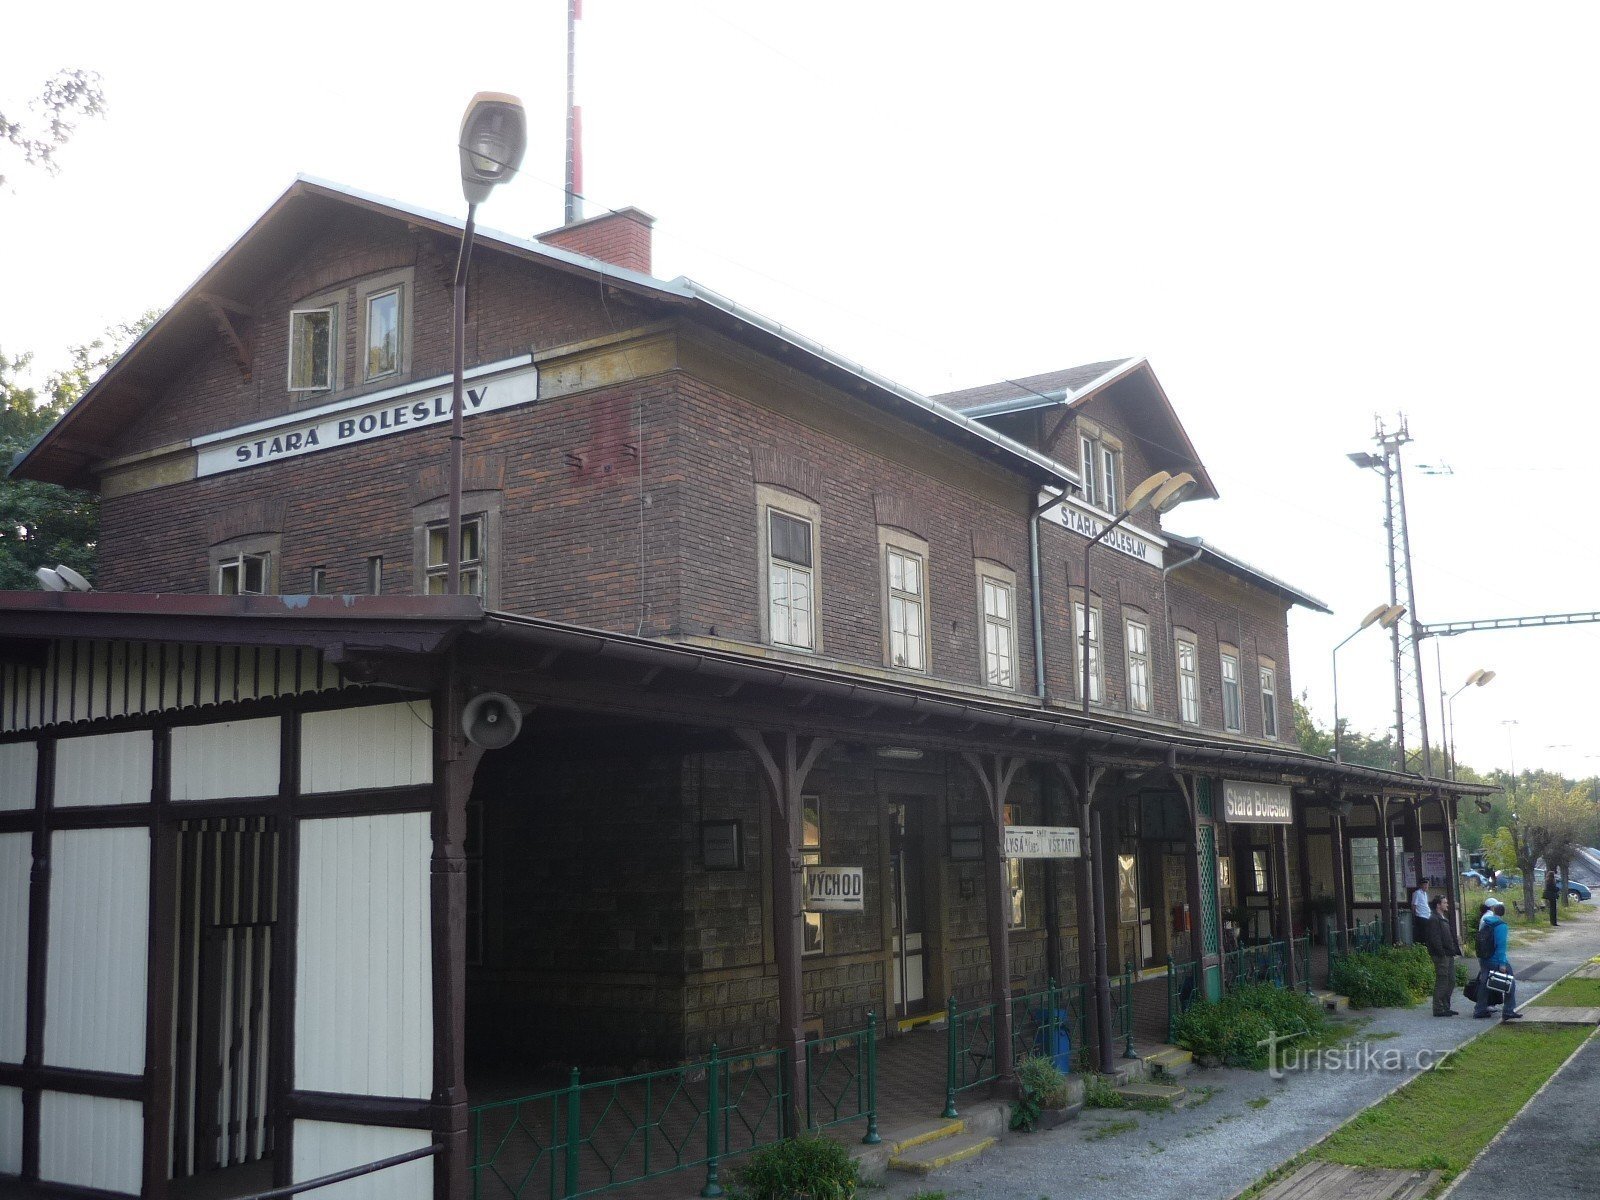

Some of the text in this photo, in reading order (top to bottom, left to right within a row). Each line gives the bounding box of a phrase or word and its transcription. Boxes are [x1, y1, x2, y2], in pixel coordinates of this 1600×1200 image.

[236, 425, 319, 462] STARÁ
[1227, 788, 1290, 818] Stará Boleslav
[808, 870, 861, 896] VÝCHOD
